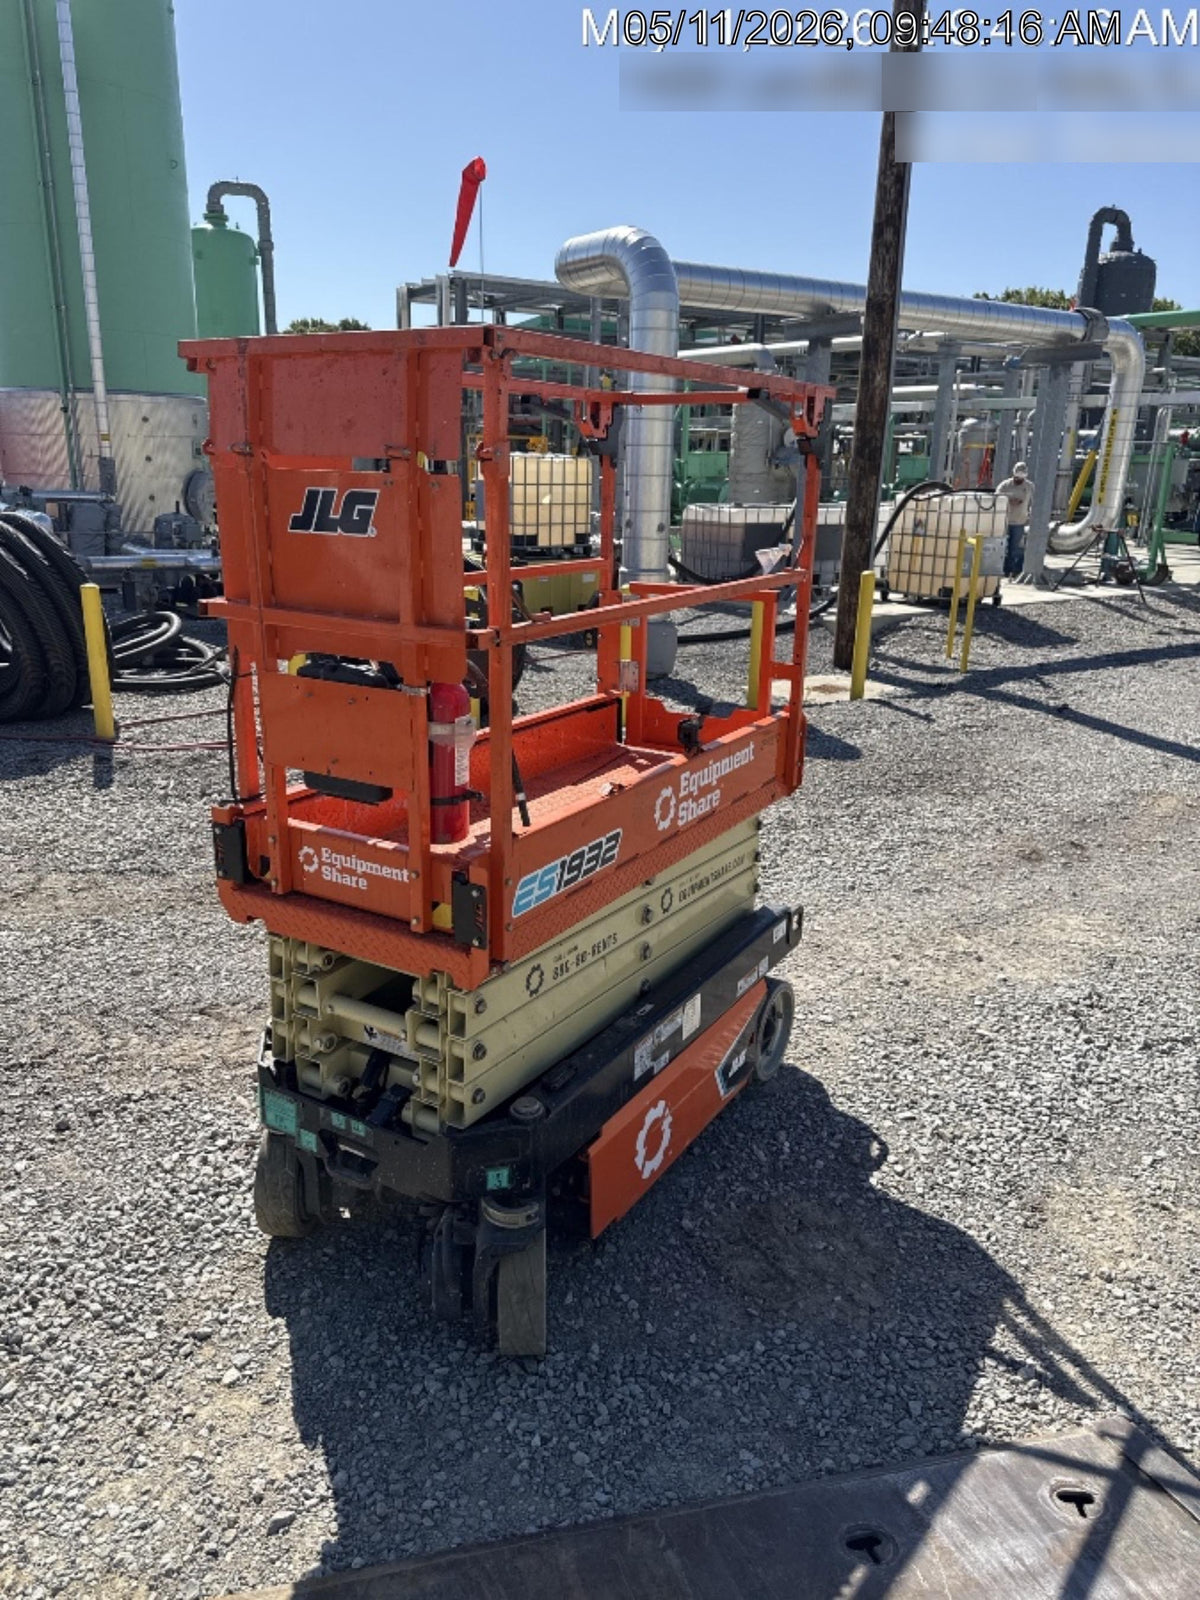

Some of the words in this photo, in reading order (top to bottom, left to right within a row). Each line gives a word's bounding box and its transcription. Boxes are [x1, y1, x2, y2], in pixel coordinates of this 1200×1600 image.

[287, 486, 380, 537] JLG
[678, 741, 755, 798] Equipment
[677, 789, 721, 826] Share
[321, 847, 410, 883] Equipment
[321, 865, 368, 890] Share
